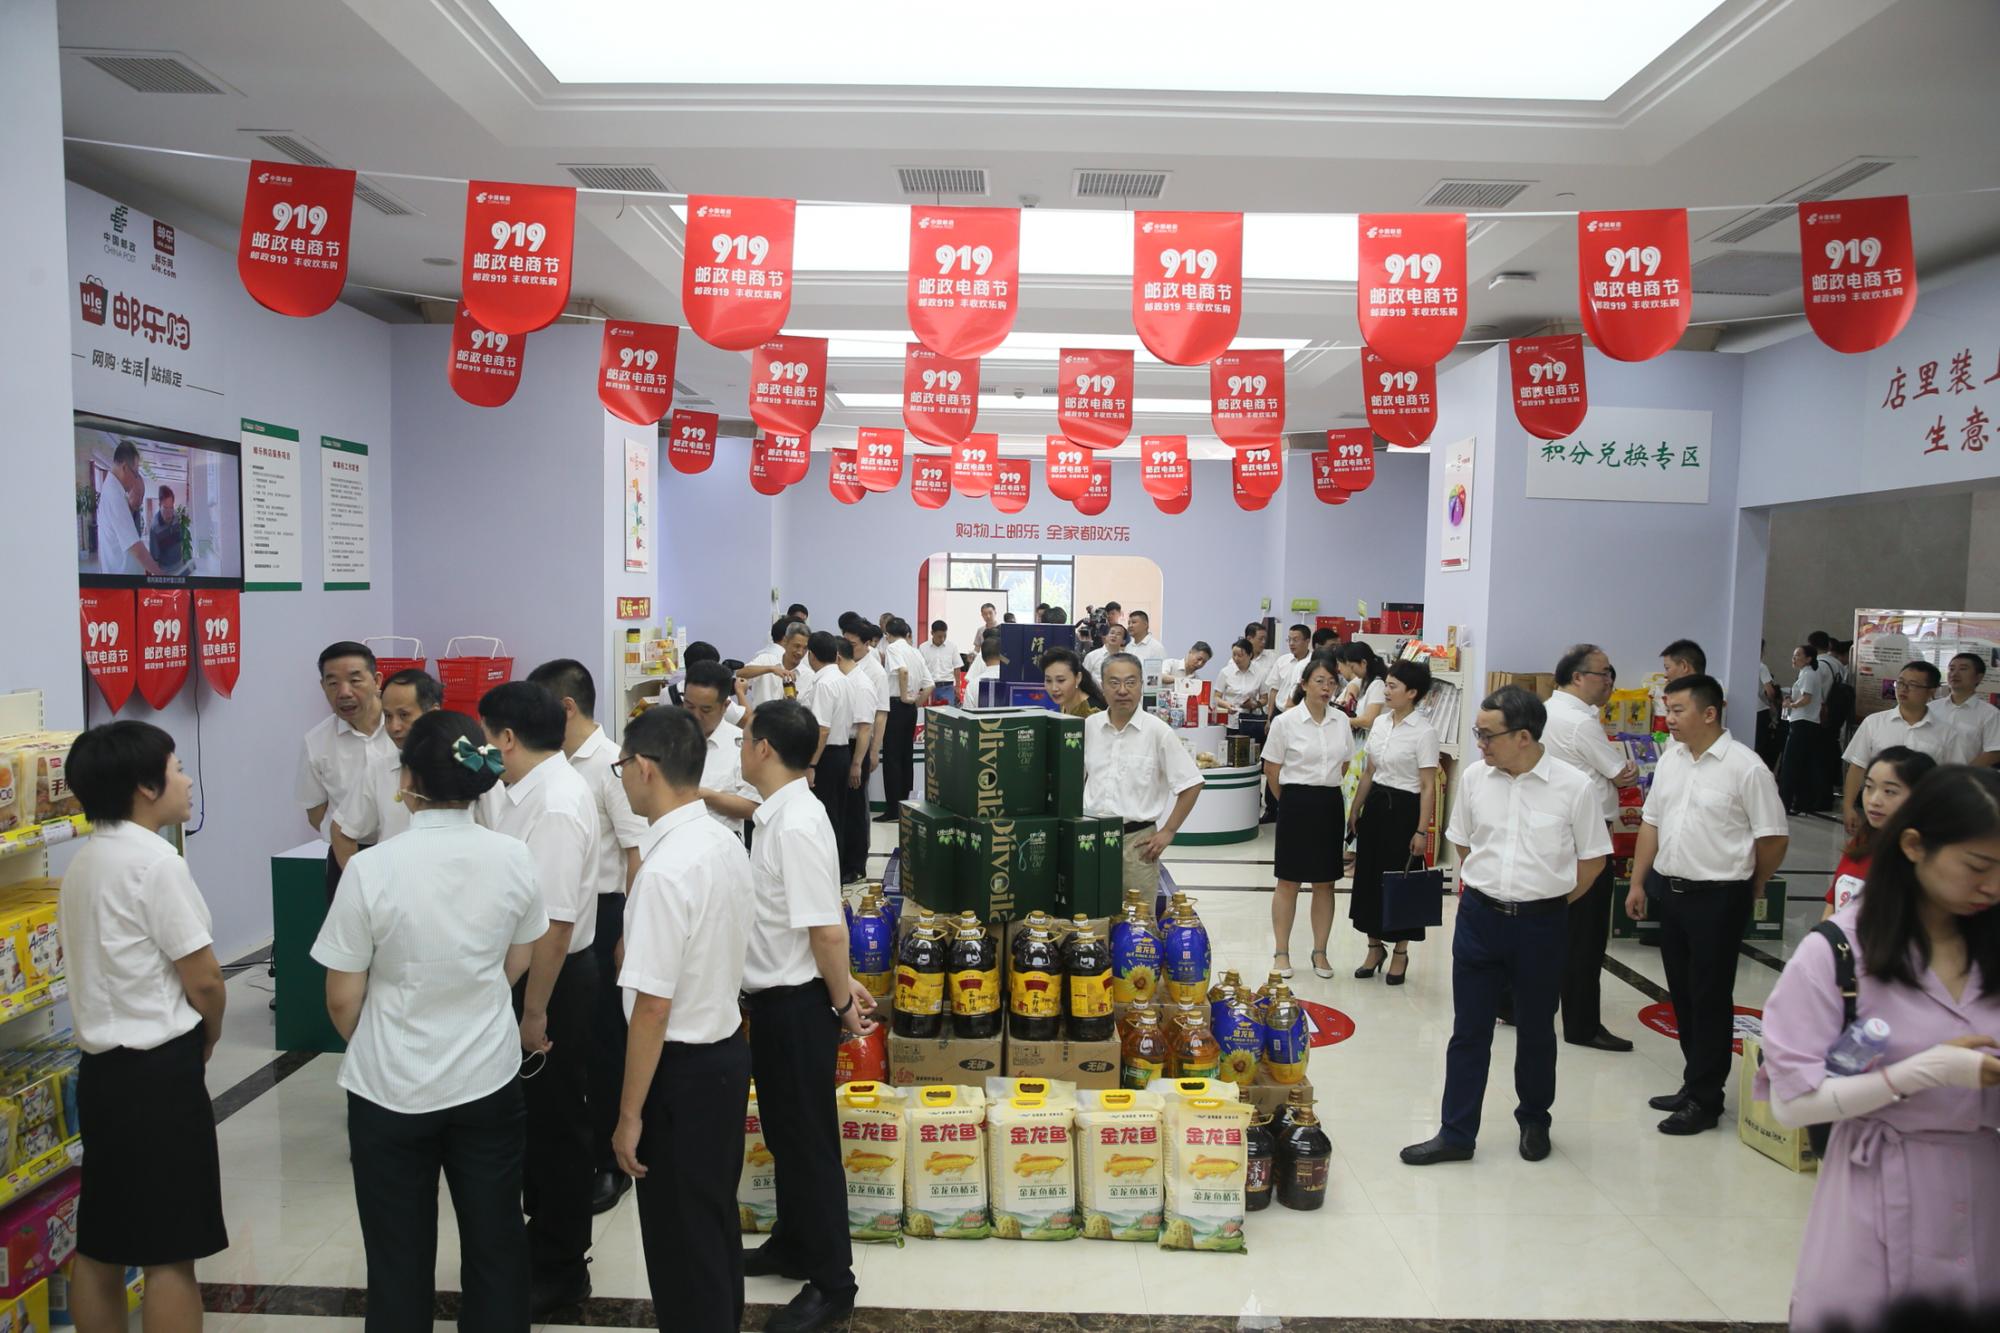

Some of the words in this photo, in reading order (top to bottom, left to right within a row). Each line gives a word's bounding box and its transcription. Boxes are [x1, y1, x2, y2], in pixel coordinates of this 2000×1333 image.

[273, 202, 327, 236] 919
[103, 232, 136, 253] 中国邮政
[252, 231, 340, 257] 邮政电商节
[491, 221, 546, 252] 919
[104, 245, 122, 258] CHINA
[123, 250, 136, 263] POST
[712, 234, 769, 265] 919
[1825, 237, 1881, 269] 919
[250, 251, 288, 264] 邮政919
[294, 257, 338, 270] 丰收欢乐购
[474, 253, 560, 273] 邮政电商节
[935, 245, 993, 275] 919
[1160, 249, 1218, 279] 919
[1384, 254, 1442, 284] 919
[1605, 246, 1661, 277] 919
[151, 263, 176, 279] ule.com
[473, 273, 507, 283] 邮政919
[512, 275, 557, 286] 丰收欢乐购
[695, 266, 784, 287] 邮政电商节
[1812, 269, 1902, 291] 邮政电商节
[694, 287, 729, 296] 邮政919
[736, 288, 782, 300] 丰收欢乐购
[919, 279, 1008, 296] 邮政电商节
[1145, 282, 1232, 300] 邮政电商节
[1370, 287, 1458, 305] 邮政电商节
[1594, 279, 1679, 298] 邮政电商节
[1813, 294, 1846, 303] 邮政919
[1852, 288, 1903, 301] 丰收欢乐购
[83, 292, 102, 310] ule
[918, 299, 954, 307] 邮政919
[960, 300, 1007, 310] 丰收欢乐购
[1144, 302, 1180, 312] 邮政919
[1186, 302, 1230, 314] 丰收欢乐购
[113, 291, 191, 350] 邮乐购
[1370, 307, 1406, 317] 邮政919
[1411, 307, 1458, 317] 丰收欢乐购
[471, 329, 508, 352] 919
[456, 350, 516, 368] 邮政电商节
[620, 347, 659, 370] 919
[606, 368, 667, 385] 邮政电商节
[769, 361, 808, 383] 919
[923, 369, 962, 391] 919
[1529, 362, 1567, 384] 919
[757, 383, 817, 397] 邮政电商节
[1076, 374, 1115, 396] 919
[1228, 375, 1267, 396] 919
[1380, 371, 1418, 393] 919
[1520, 383, 1579, 398] 邮政电商节
[910, 392, 971, 406] 邮政电商节
[1065, 397, 1125, 411] 邮政电商节
[1217, 398, 1278, 410] 邮政电商节
[1371, 394, 1430, 407] 邮政电商节
[682, 426, 706, 441] 919
[1924, 405, 2000, 455] 生意
[673, 439, 711, 450] 邮政电商节
[775, 436, 800, 449] 919
[868, 444, 892, 457] 919
[1339, 444, 1363, 458] 919
[768, 448, 805, 458] 邮政电商节
[861, 457, 899, 467] 邮政电商节
[962, 449, 987, 462] 919
[1058, 452, 1083, 464] 919
[1152, 452, 1177, 464] 919
[1246, 449, 1271, 463] 919
[1540, 440, 1701, 470] 积分兑换专区
[954, 462, 993, 472] 邮政电商节
[1051, 465, 1089, 473] 邮政电商节
[1334, 458, 1371, 467] 邮政电商节
[921, 468, 943, 480] 919
[1000, 472, 1021, 484] 919
[915, 479, 947, 488] 邮政电商节
[994, 483, 1026, 492] 邮政电商节
[955, 523, 1040, 540] 购物上邮乐
[1046, 524, 1130, 542] 全家都欢乐
[88, 621, 119, 647] 919
[153, 618, 181, 643] 919
[205, 618, 229, 640] 919
[145, 645, 186, 660] 邮政电商节
[203, 642, 235, 656] 邮政电商节
[841, 1121, 899, 1142] 金龙鱼
[919, 1123, 977, 1143] 金龙鱼
[1010, 1126, 1068, 1145] 金龙鱼
[1100, 1126, 1158, 1145] 金龙鱼
[1185, 1126, 1242, 1146] 金龙鱼
